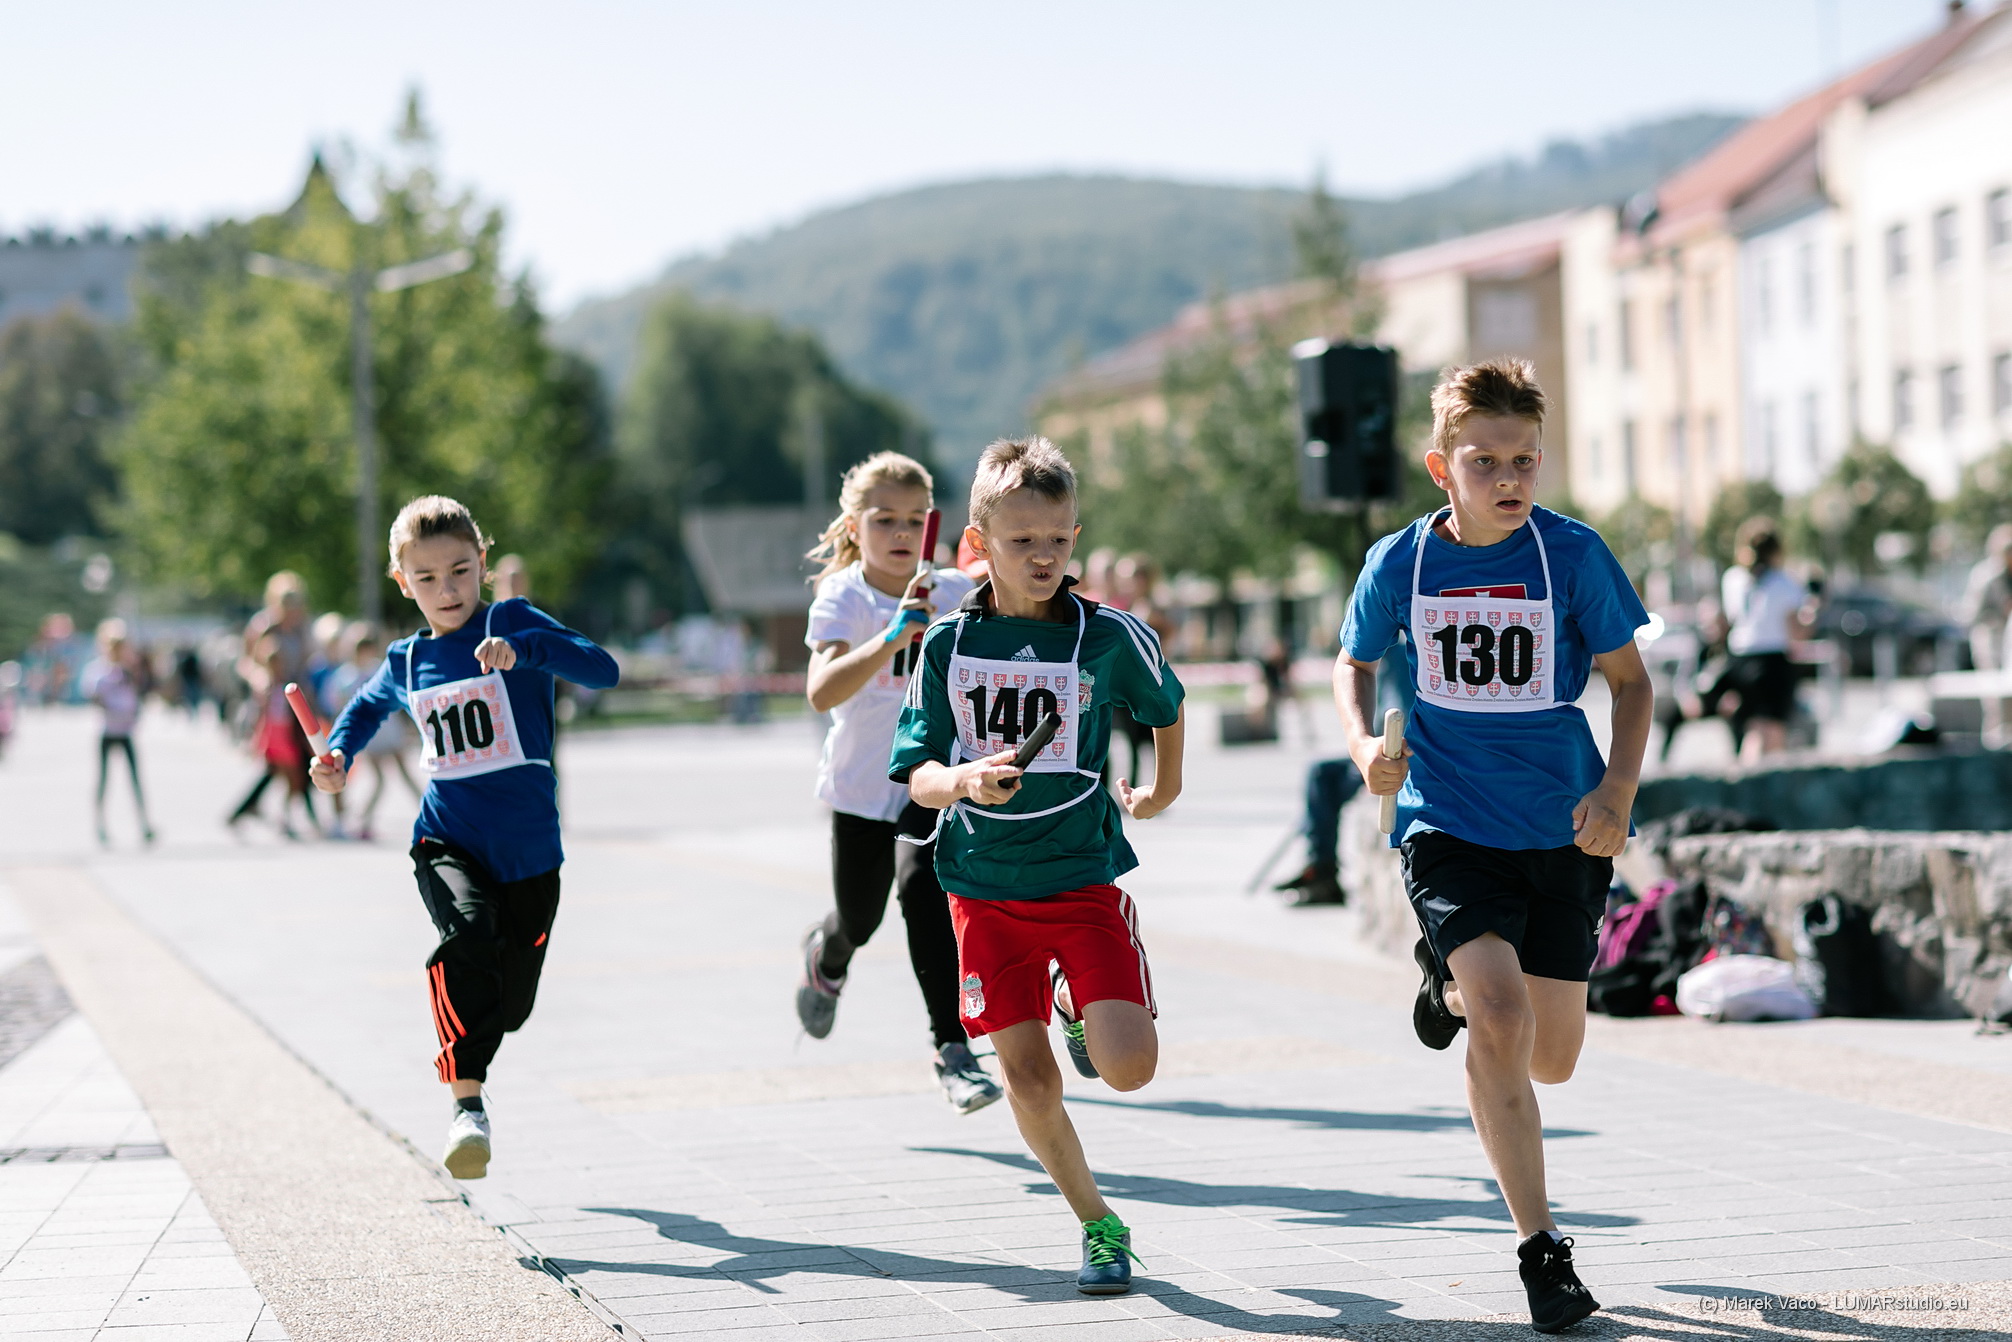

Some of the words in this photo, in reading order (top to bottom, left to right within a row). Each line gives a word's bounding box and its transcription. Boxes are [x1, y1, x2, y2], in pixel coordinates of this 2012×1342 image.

[1432, 624, 1534, 686] 130
[426, 699, 494, 757] 110
[965, 685, 1058, 746] 140
